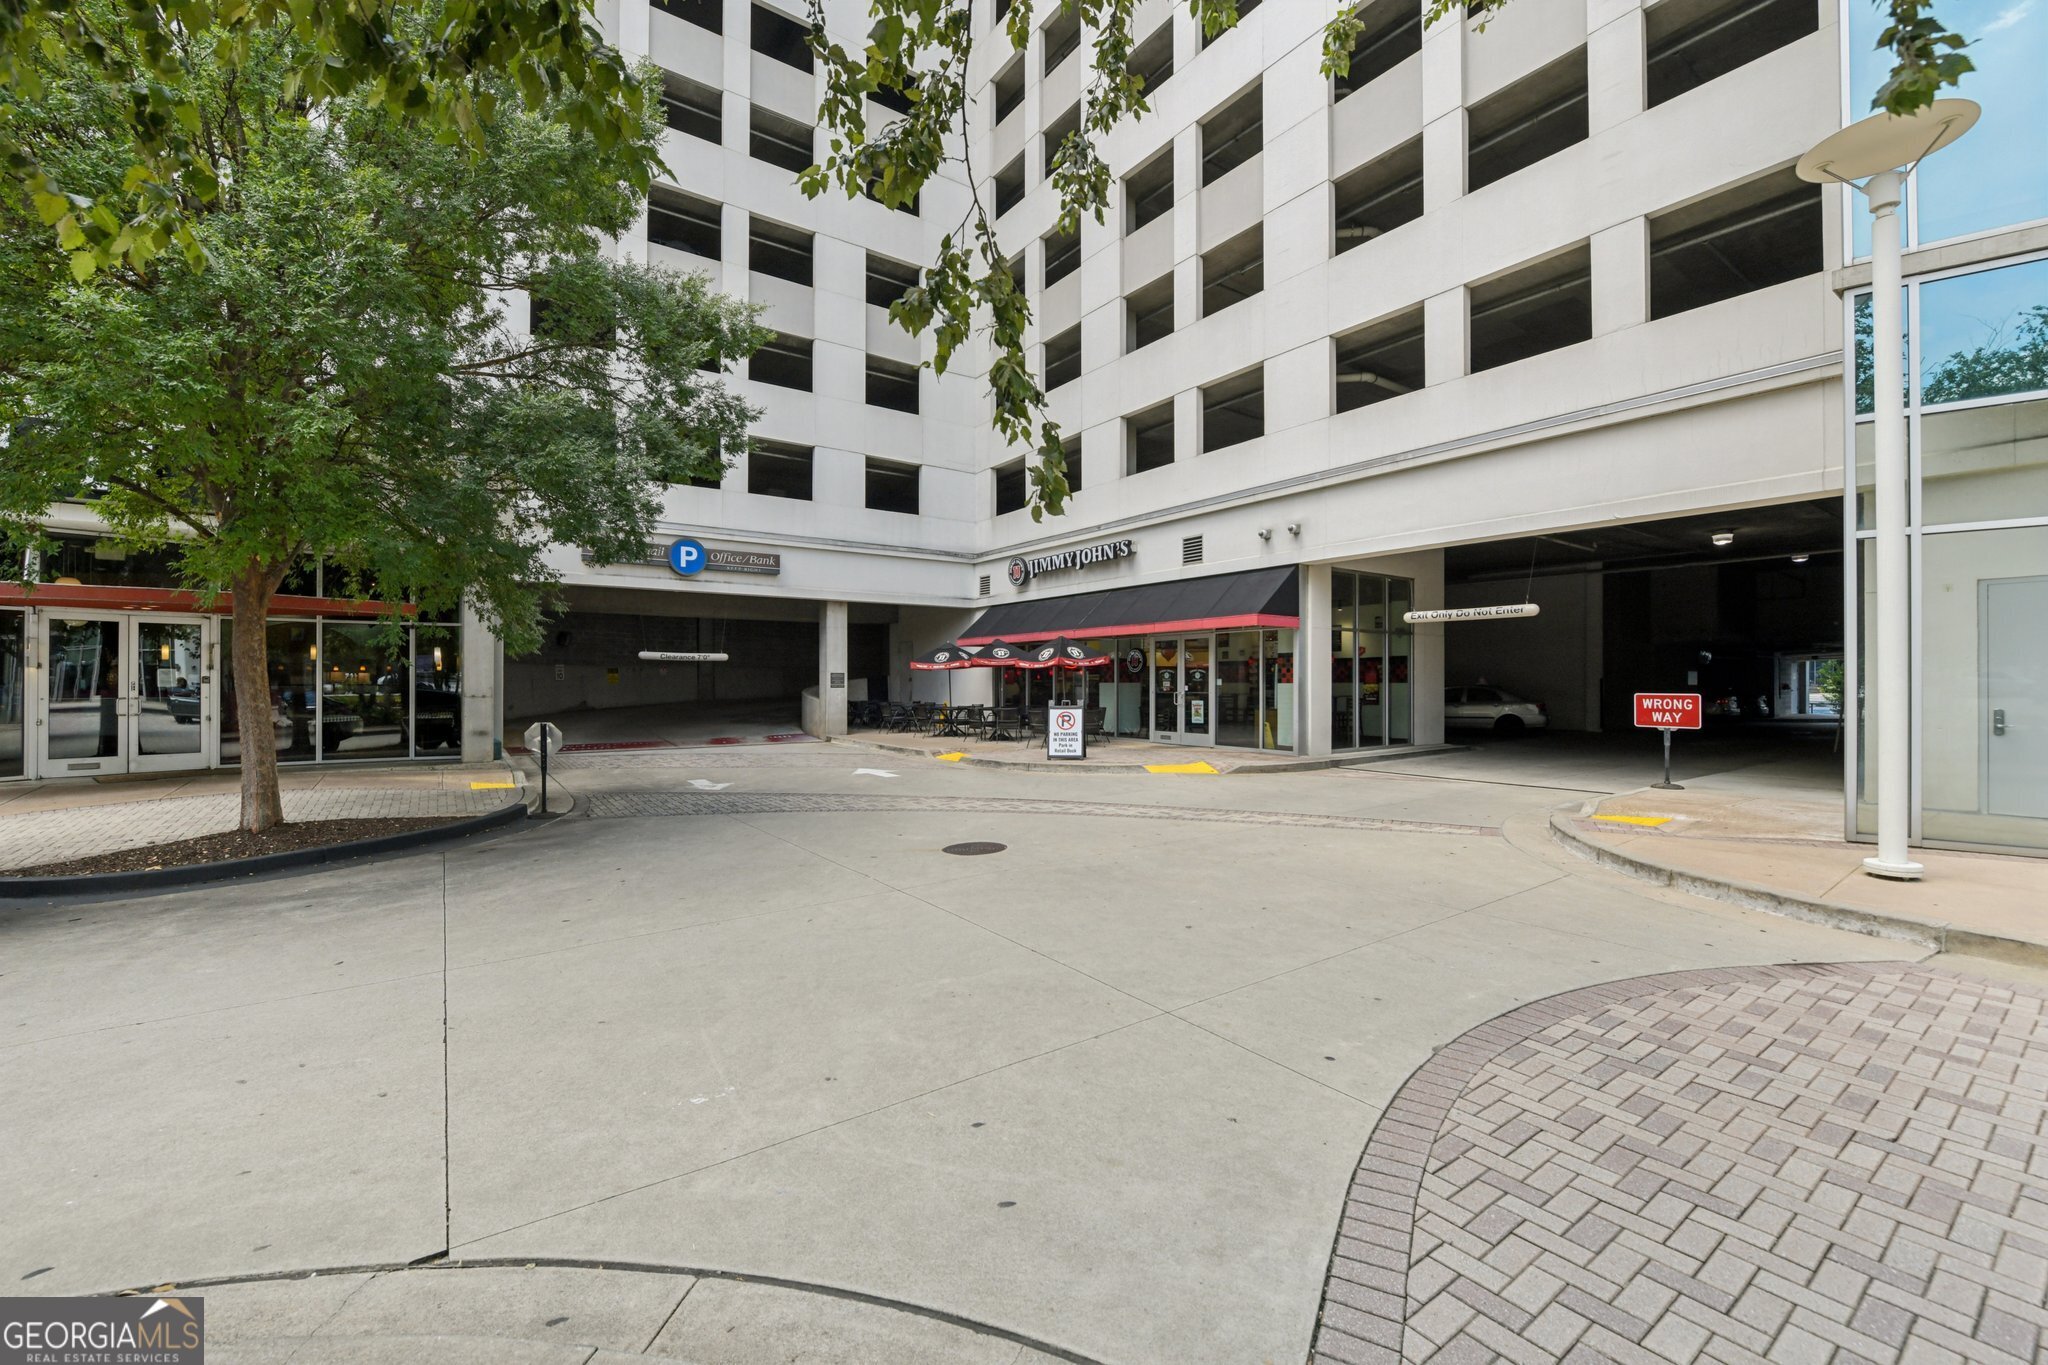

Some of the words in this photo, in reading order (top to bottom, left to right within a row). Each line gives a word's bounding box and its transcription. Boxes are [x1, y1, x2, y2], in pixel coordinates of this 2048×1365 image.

[680, 546, 698, 567] P
[711, 552, 776, 566] Office/Bank
[1029, 551, 1074, 578] JIMMY
[1075, 540, 1129, 570] JOHN'S
[1431, 611, 1453, 619] Only
[1456, 609, 1470, 618] Do
[1473, 608, 1492, 617] Not
[1495, 606, 1524, 615] Enter
[660, 653, 696, 661] Clearance
[1642, 698, 1693, 710] WRONG
[1652, 711, 1682, 723] WAY
